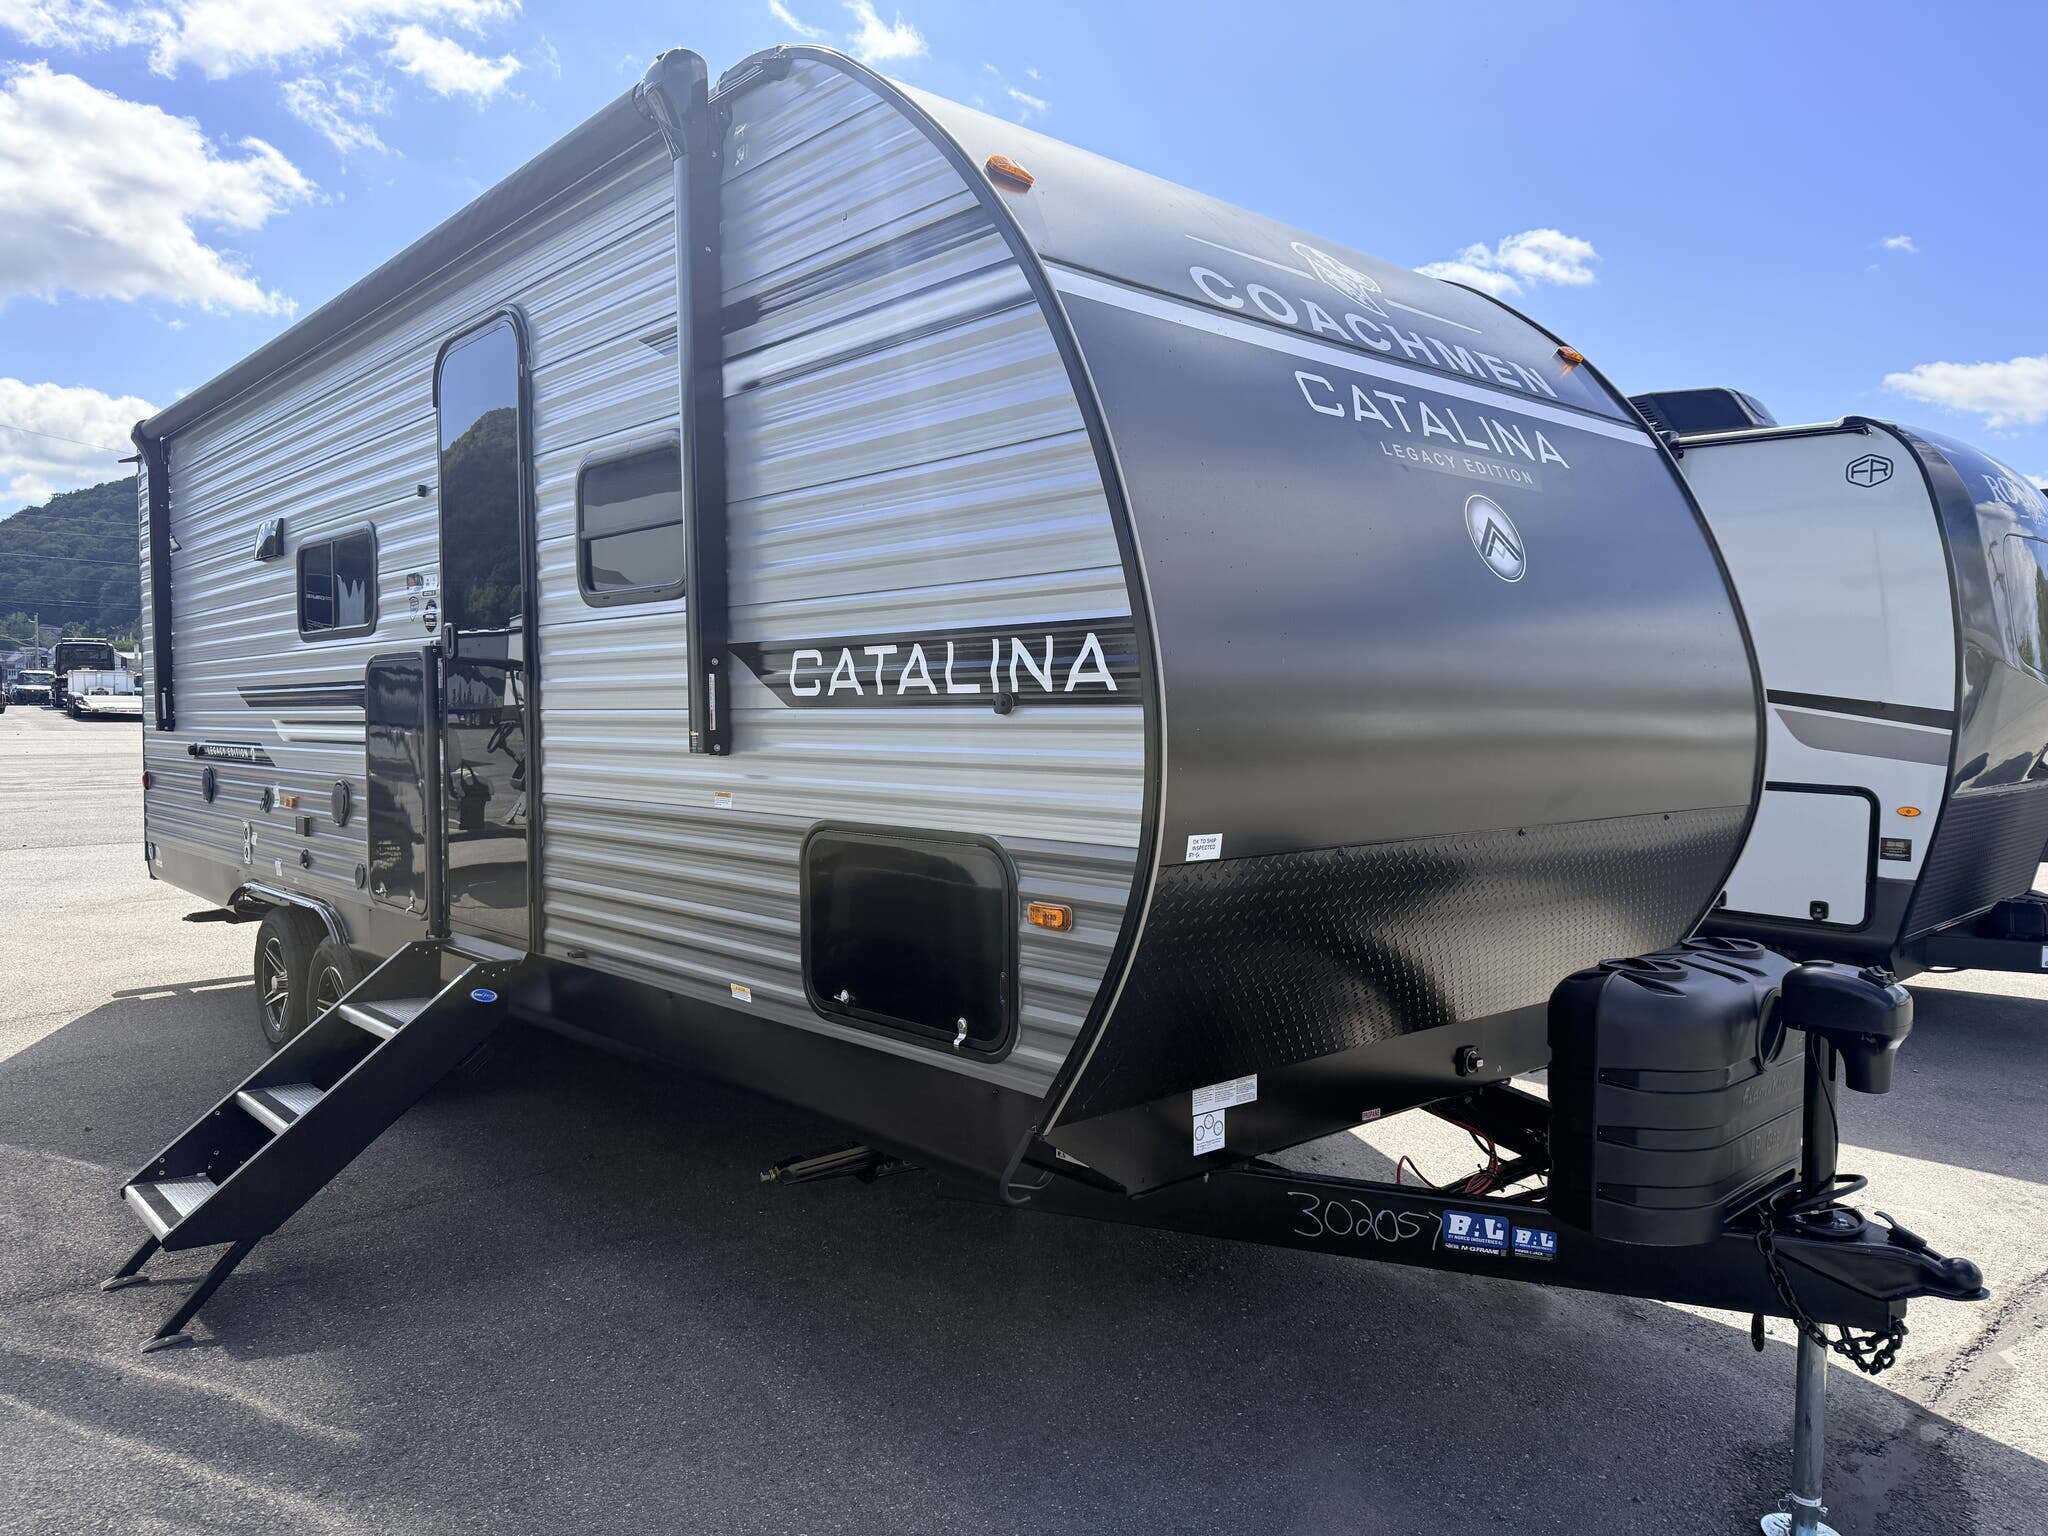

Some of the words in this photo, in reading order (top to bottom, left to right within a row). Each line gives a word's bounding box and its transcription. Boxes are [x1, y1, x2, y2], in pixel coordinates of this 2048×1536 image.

[1190, 266, 1558, 398] COACHMEN
[1294, 370, 1570, 469] CATALINA
[1380, 440, 1455, 469] LEGACY
[1463, 458, 1533, 485] EDITION
[1851, 458, 1889, 483] FR
[789, 632, 1118, 697] CATALINA
[207, 745, 226, 757] LEGACY
[227, 746, 249, 758] EDITION
[1288, 1192, 1443, 1251] 302057
[1448, 1214, 1504, 1240] BAL
[1515, 1229, 1554, 1247] BAL
